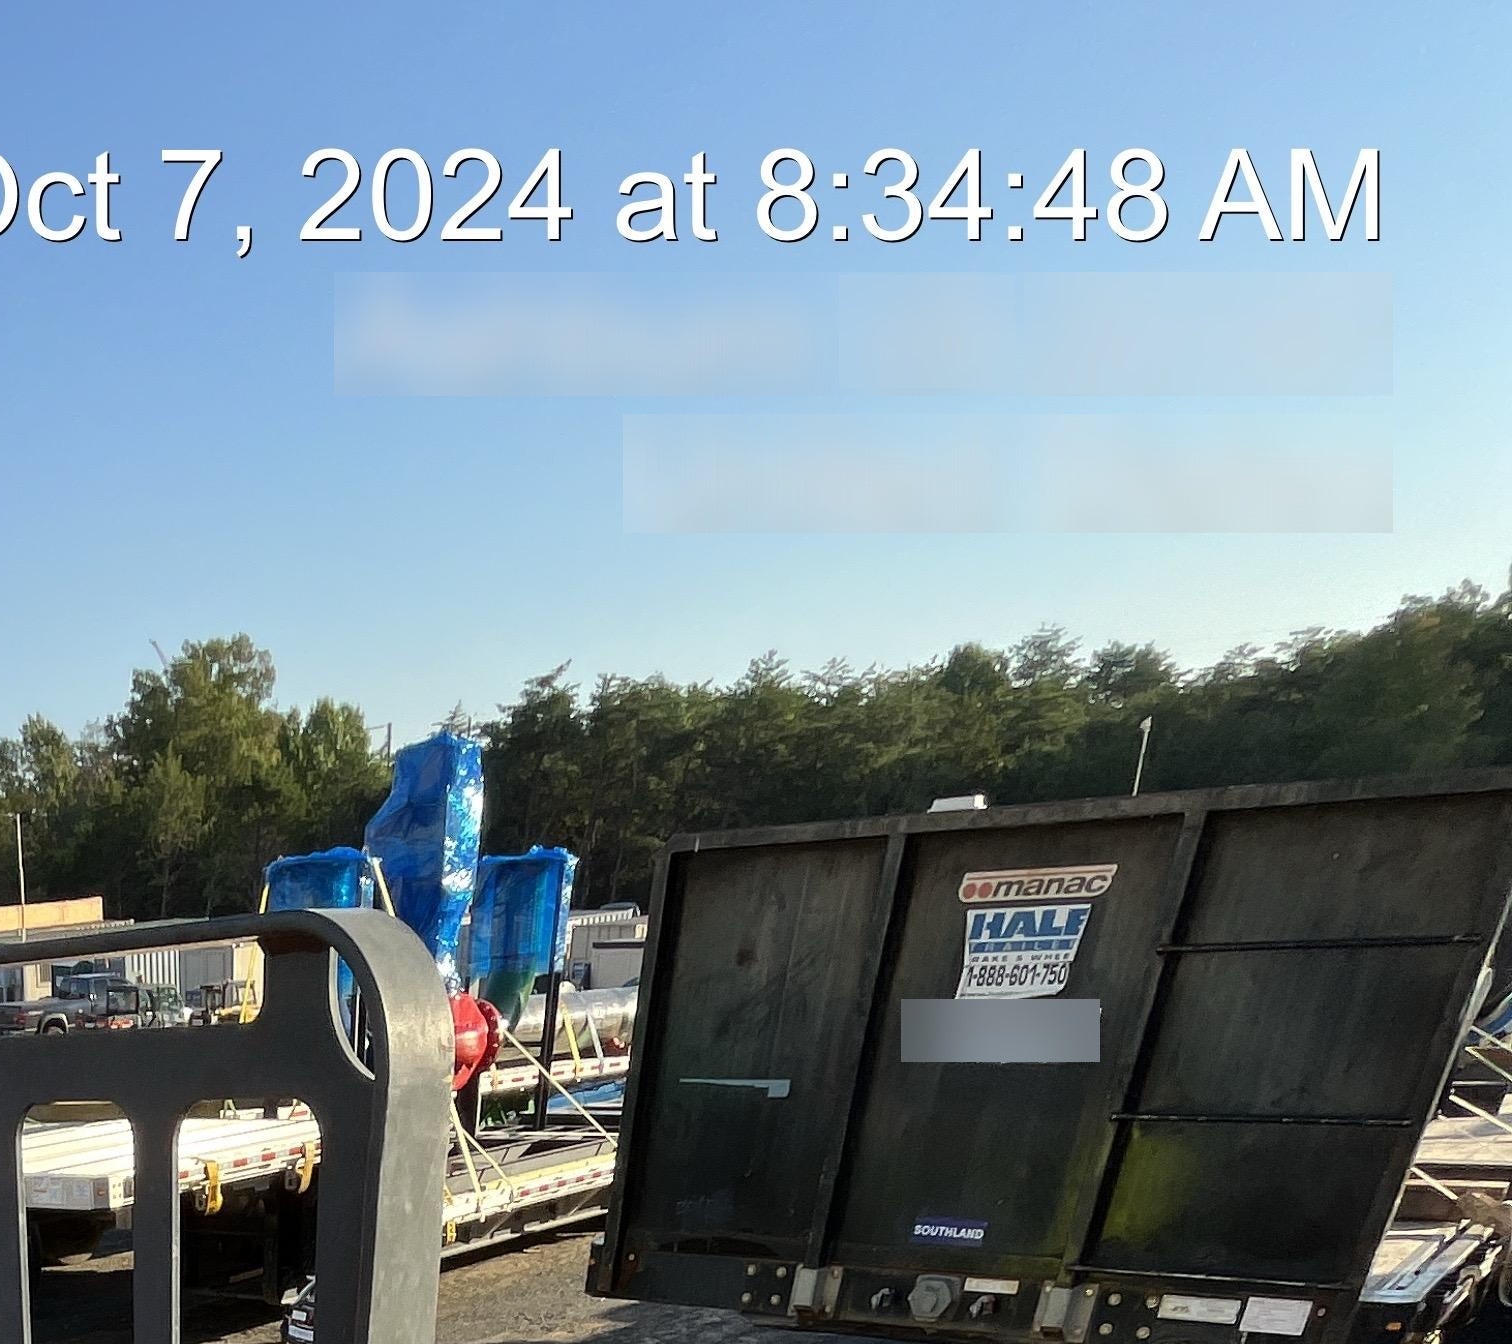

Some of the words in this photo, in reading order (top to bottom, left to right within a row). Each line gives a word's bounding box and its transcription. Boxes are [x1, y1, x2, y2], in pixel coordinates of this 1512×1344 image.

[992, 875, 1108, 898] manac
[966, 962, 1068, 987] 1-888-601-750
[913, 1223, 985, 1241] SOUTHLAND
